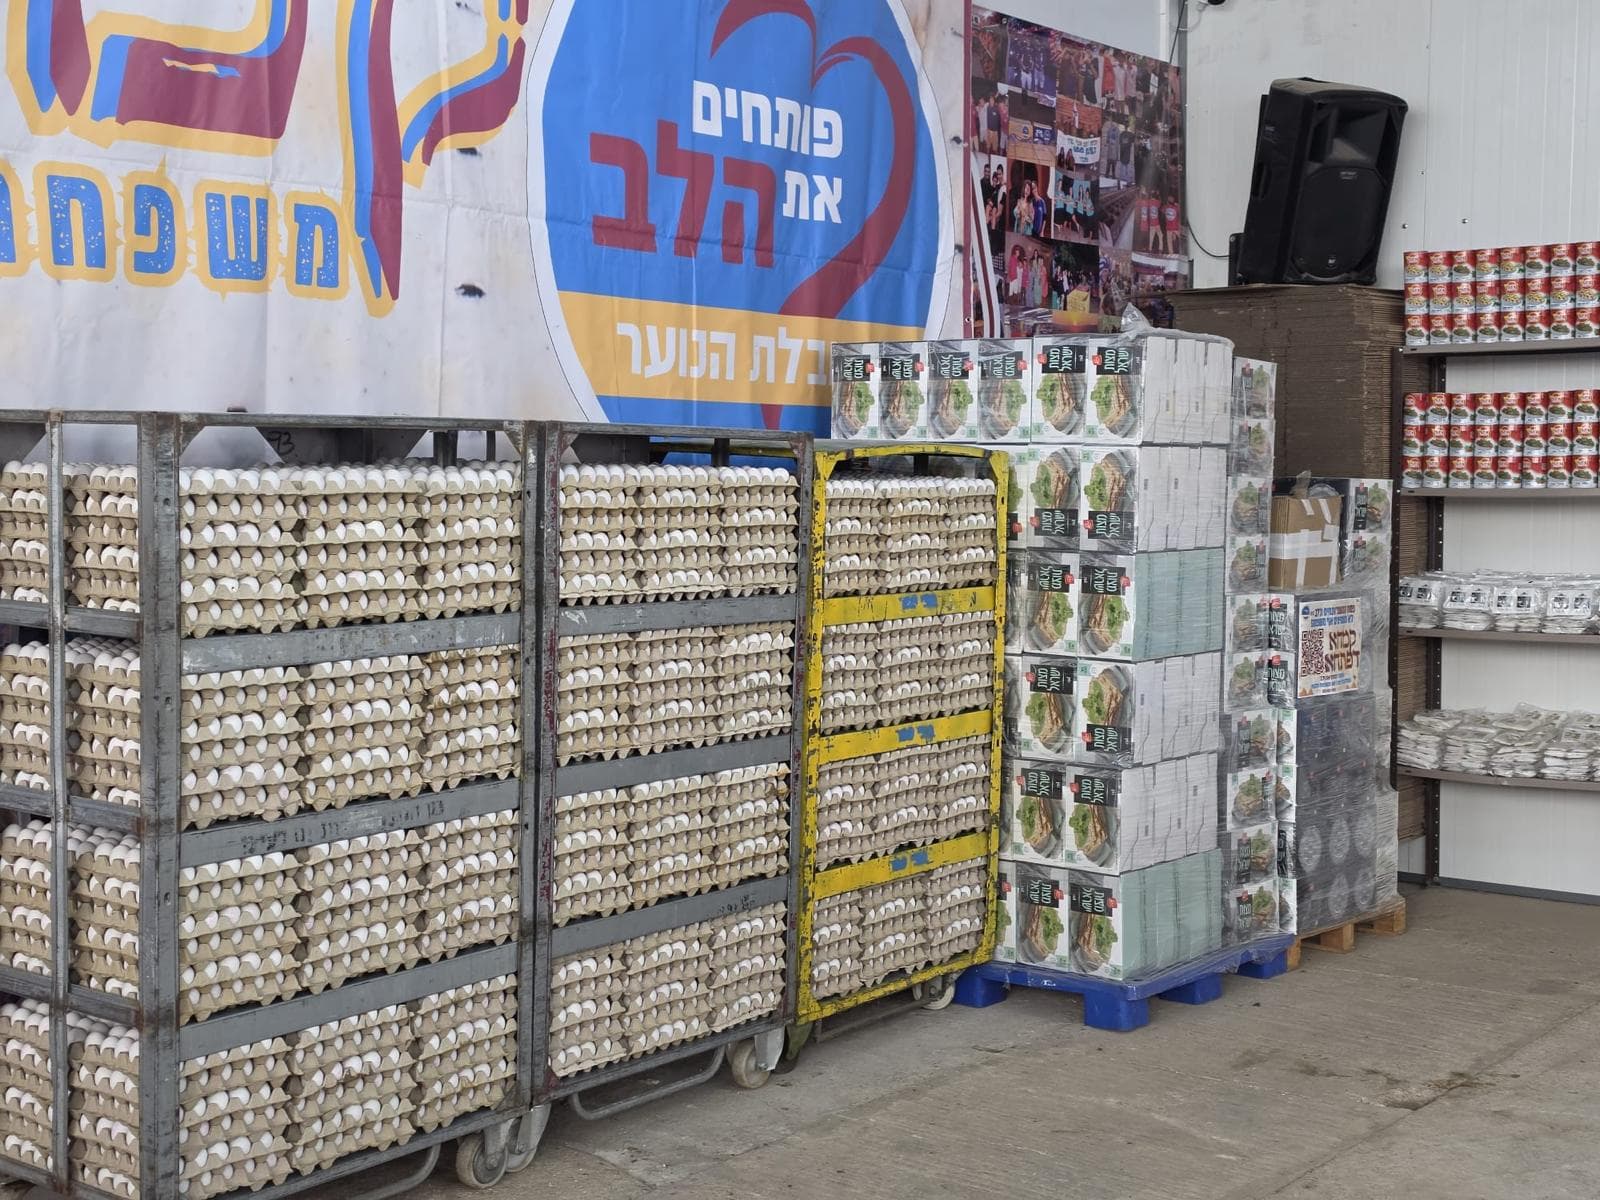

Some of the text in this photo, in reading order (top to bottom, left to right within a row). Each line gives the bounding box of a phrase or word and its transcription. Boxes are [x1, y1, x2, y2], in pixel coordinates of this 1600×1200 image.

[693, 80, 843, 158] פותחים
[590, 119, 842, 268] את הלב
[0, 174, 338, 287] משפח
[617, 322, 832, 384] בלת הנוער
[1049, 348, 1060, 368] מצות
[1058, 346, 1073, 372] ישראל
[1104, 349, 1116, 370] מצות
[1114, 347, 1129, 373] ישראל
